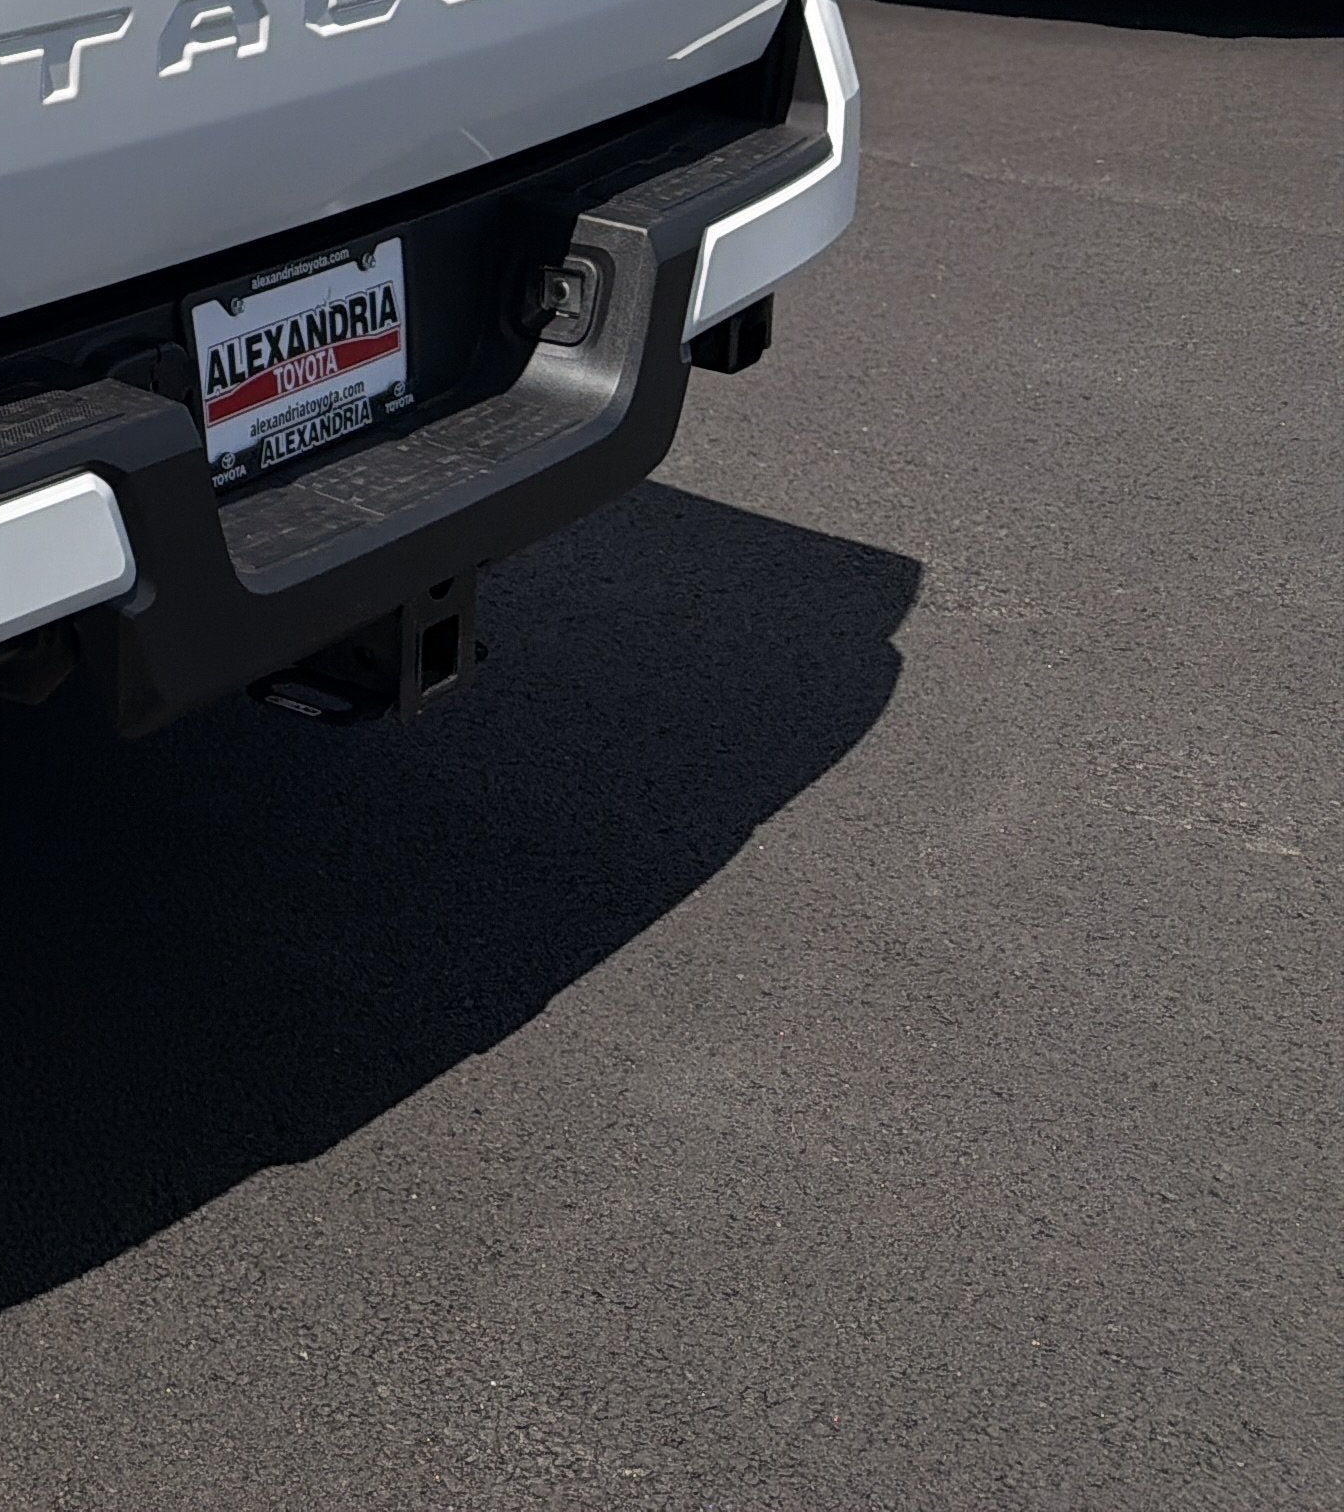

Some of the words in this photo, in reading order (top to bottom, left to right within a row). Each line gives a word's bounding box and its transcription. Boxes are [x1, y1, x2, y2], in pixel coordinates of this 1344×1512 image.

[251, 248, 350, 290] alexandriatoyota.com
[206, 283, 399, 396] ALEXANDRIA
[273, 347, 338, 394] TOYOTA
[250, 380, 364, 437] alexandriatoyota.com
[385, 394, 414, 414] TOYOTA
[261, 397, 372, 468] ALEXANDRIA
[212, 465, 247, 487] TOYOTA
